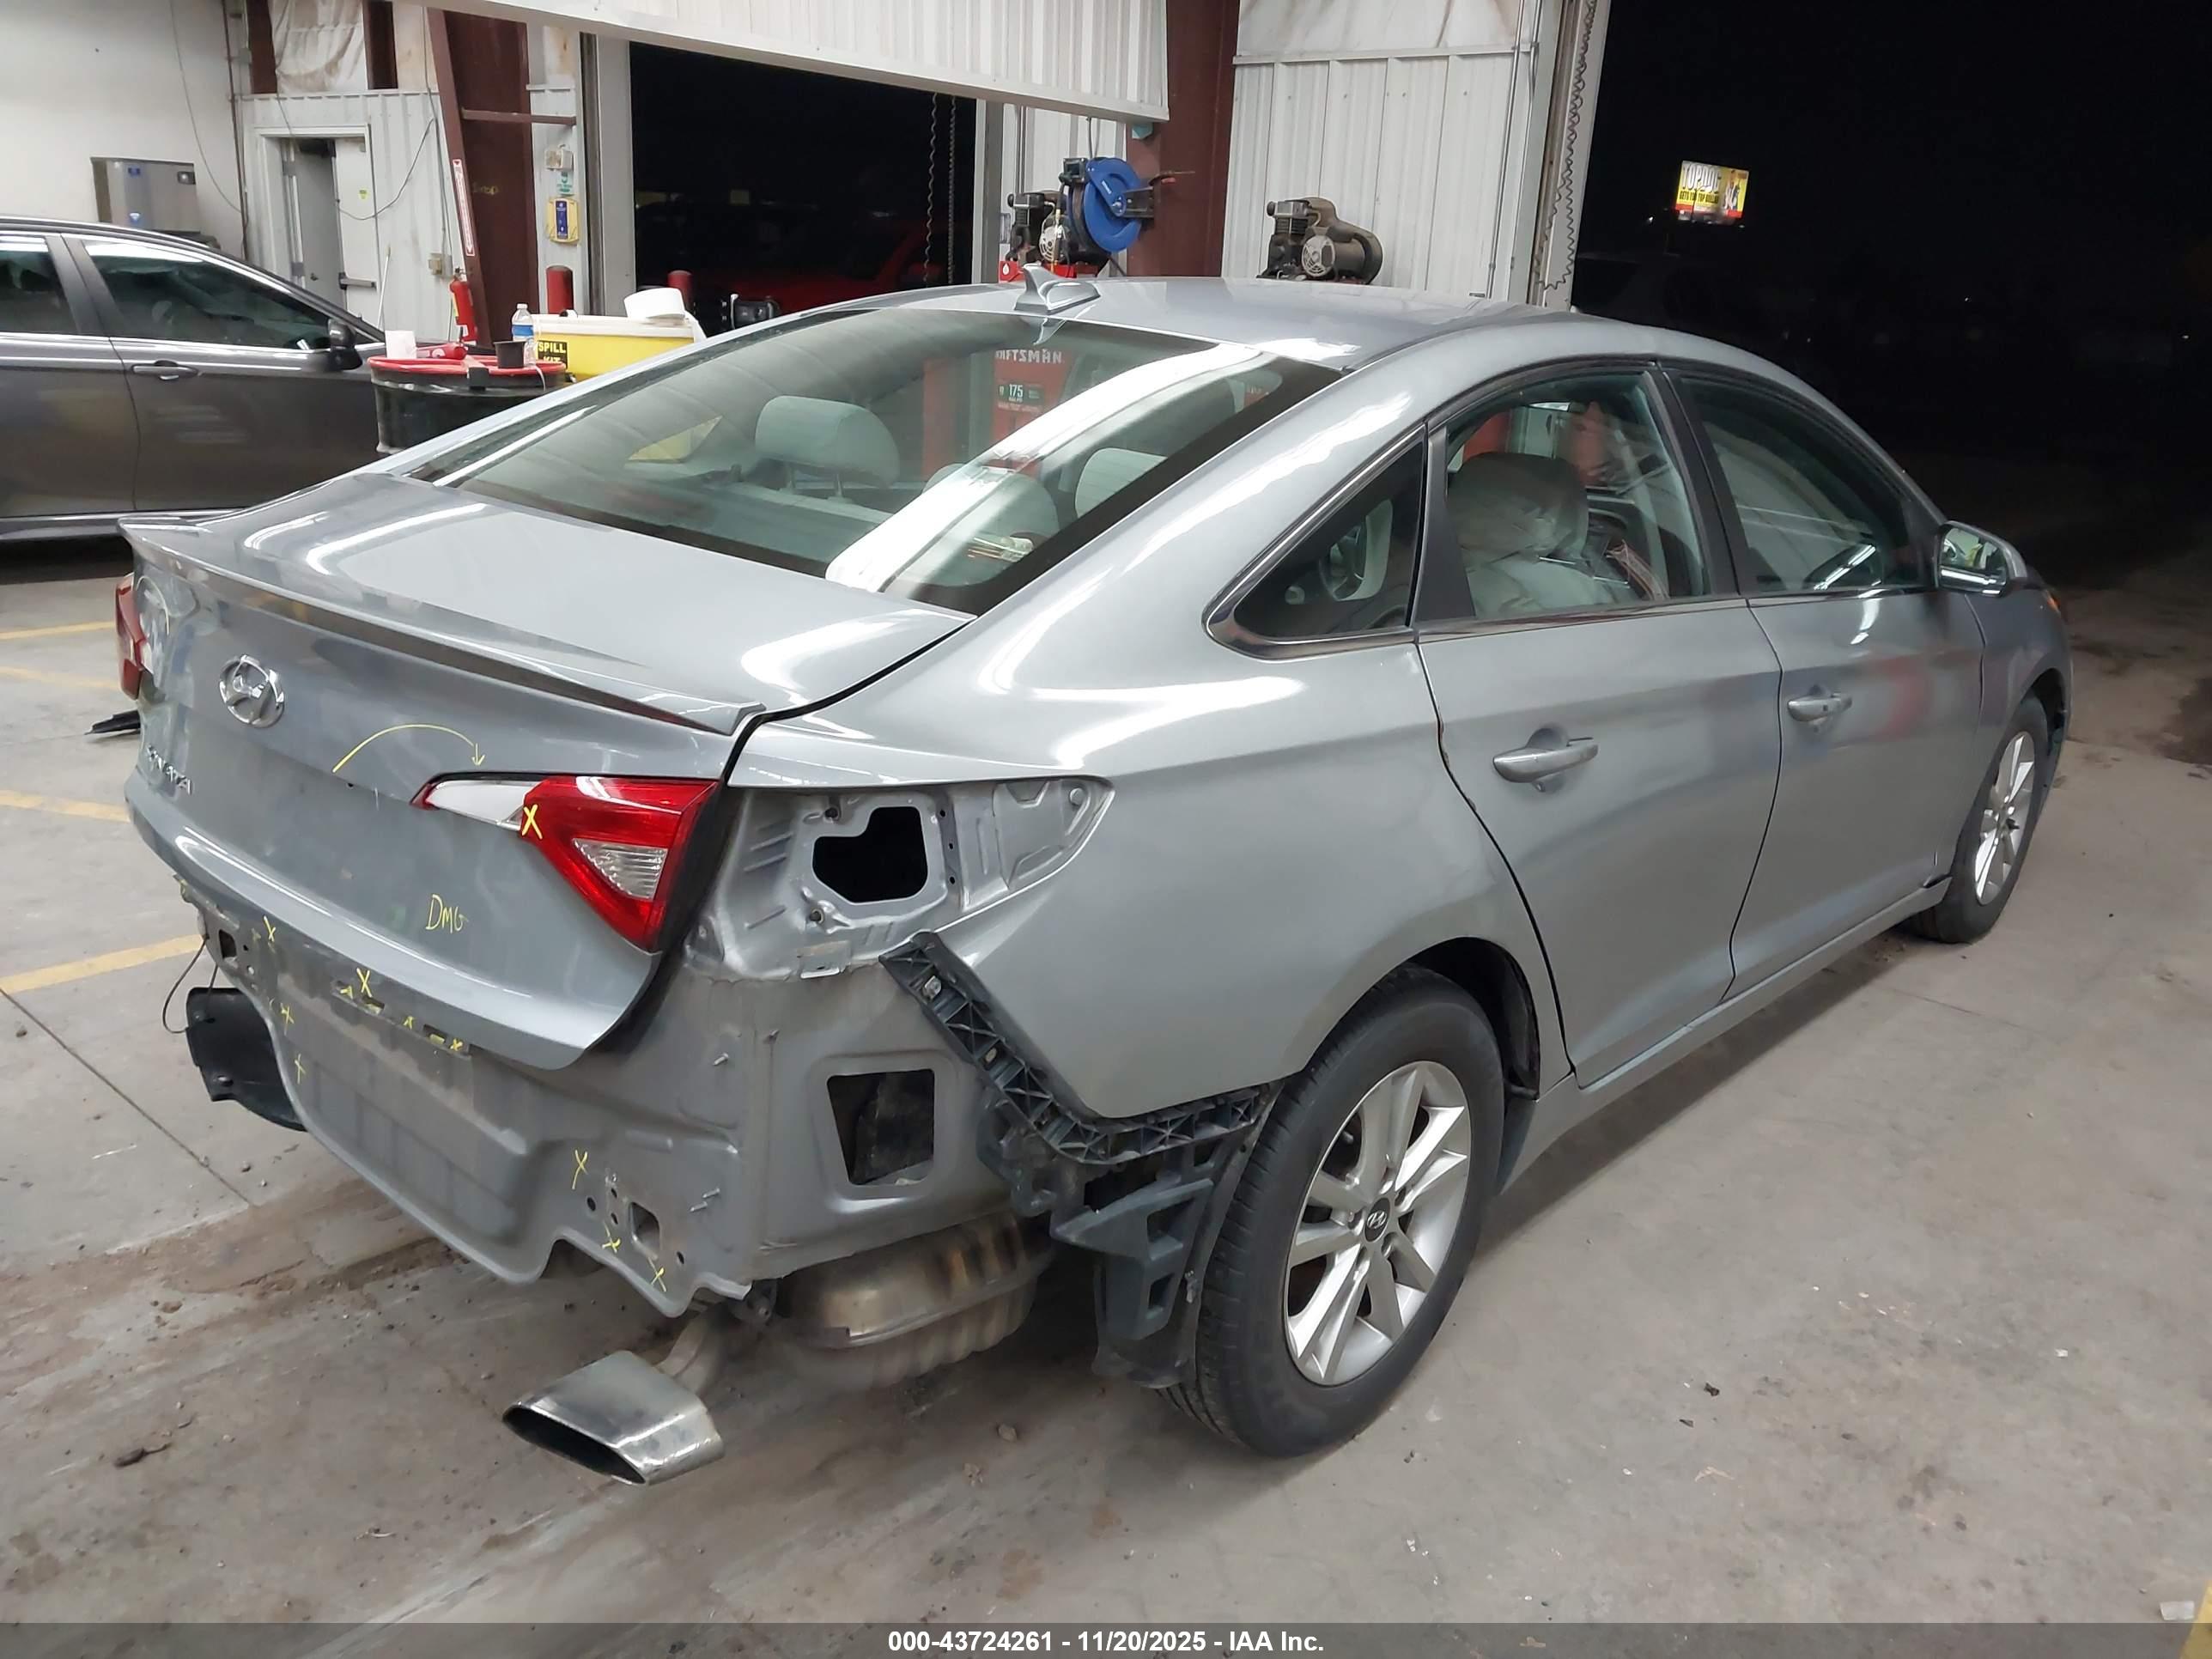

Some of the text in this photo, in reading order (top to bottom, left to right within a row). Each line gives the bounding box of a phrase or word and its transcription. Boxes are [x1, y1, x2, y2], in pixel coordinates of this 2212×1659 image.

[538, 342, 567, 353] SPILL
[1009, 384, 1024, 398] 175
[425, 894, 469, 933] DMG
